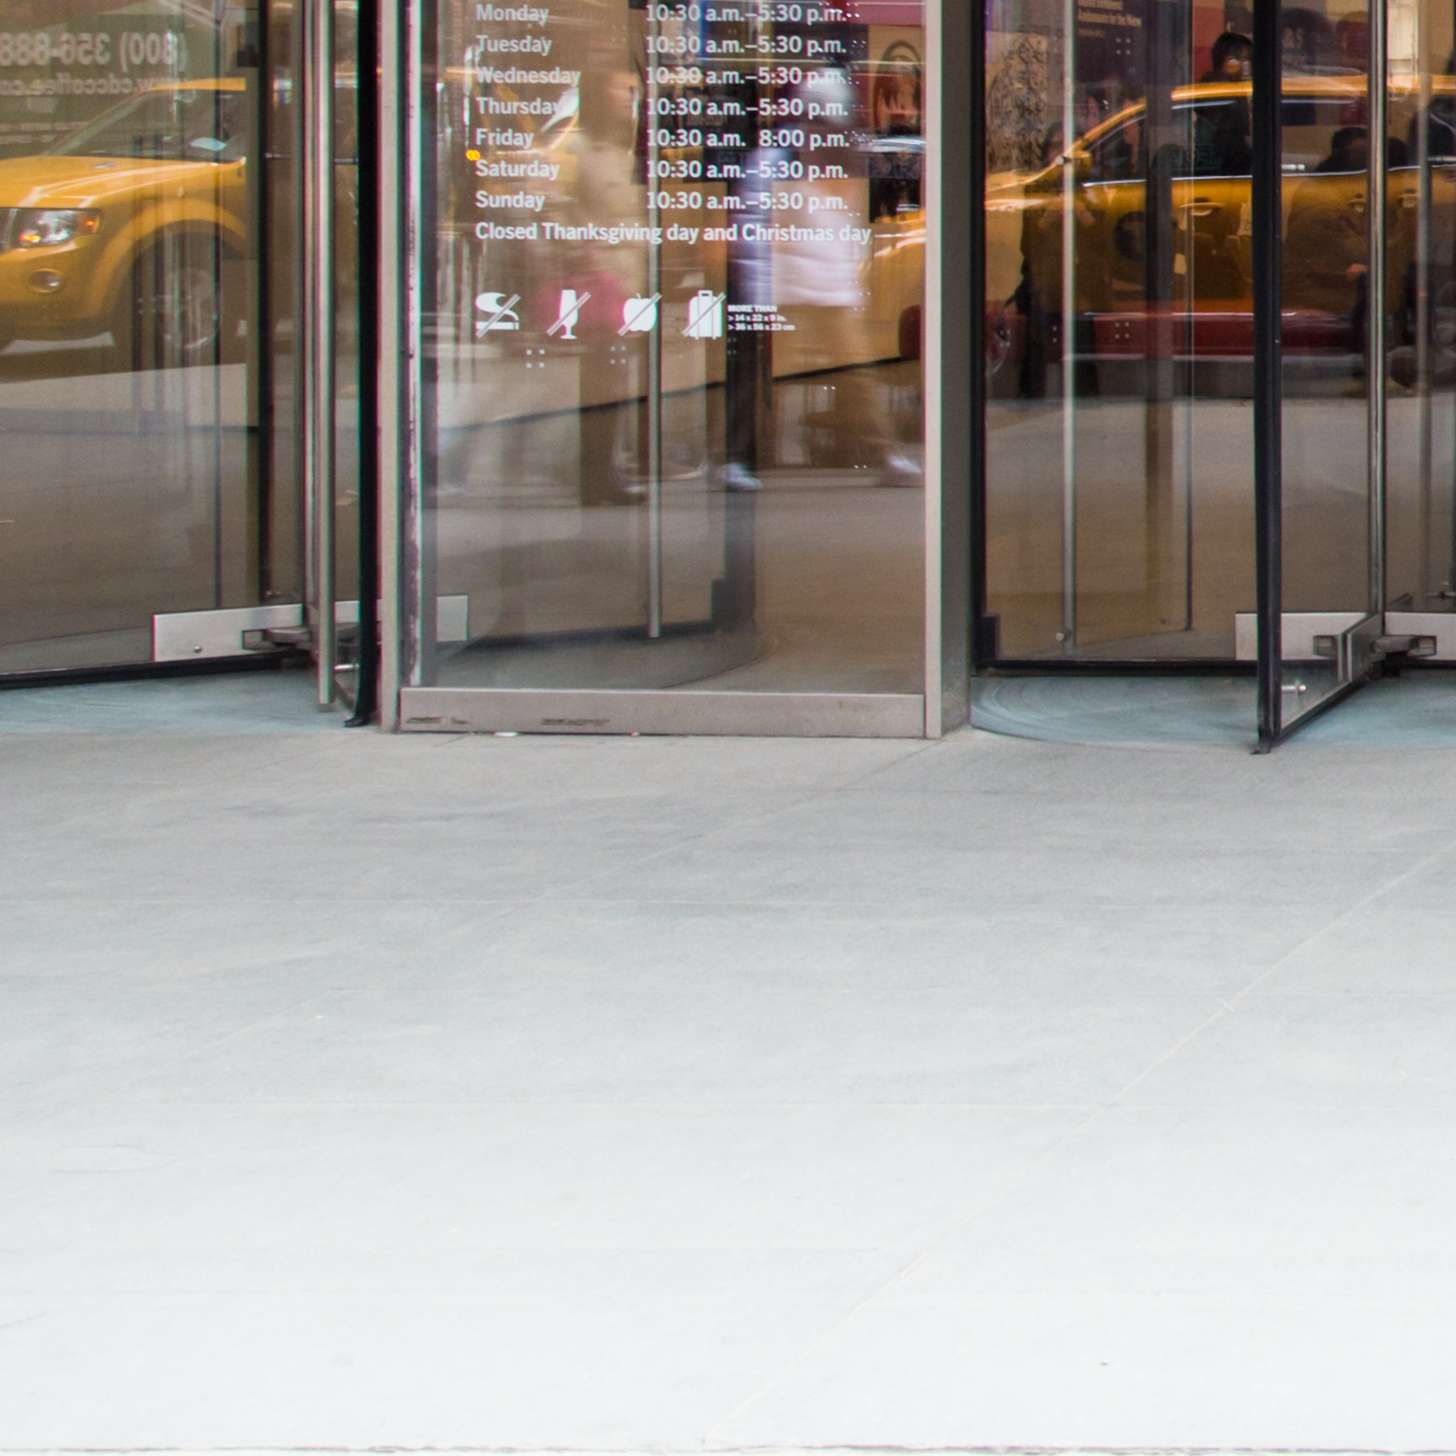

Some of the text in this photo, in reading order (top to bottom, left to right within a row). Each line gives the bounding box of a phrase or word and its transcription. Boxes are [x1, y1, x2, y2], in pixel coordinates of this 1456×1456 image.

[476, 5, 548, 26] Monday
[645, 5, 699, 23] 10:30
[807, 8, 847, 25] p.m.
[476, 36, 552, 57] Tuesday
[645, 36, 699, 54] 10:30
[807, 39, 847, 56] p.m.
[476, 67, 580, 88] Wednesday
[645, 67, 699, 85] 10:30
[646, 99, 700, 117] 10:30
[808, 102, 848, 119] p.m.
[476, 129, 535, 150] Friday
[647, 129, 701, 147] 10:30
[810, 132, 850, 150] p.m.
[476, 160, 560, 181] Saturday
[647, 160, 701, 178] 10:30
[809, 163, 849, 180] p.m.
[476, 191, 545, 212] Sunday
[647, 191, 701, 209] 10:30
[809, 194, 849, 211] p.m.
[475, 222, 871, 244] Closed Thanksgiving day and Christmas day
